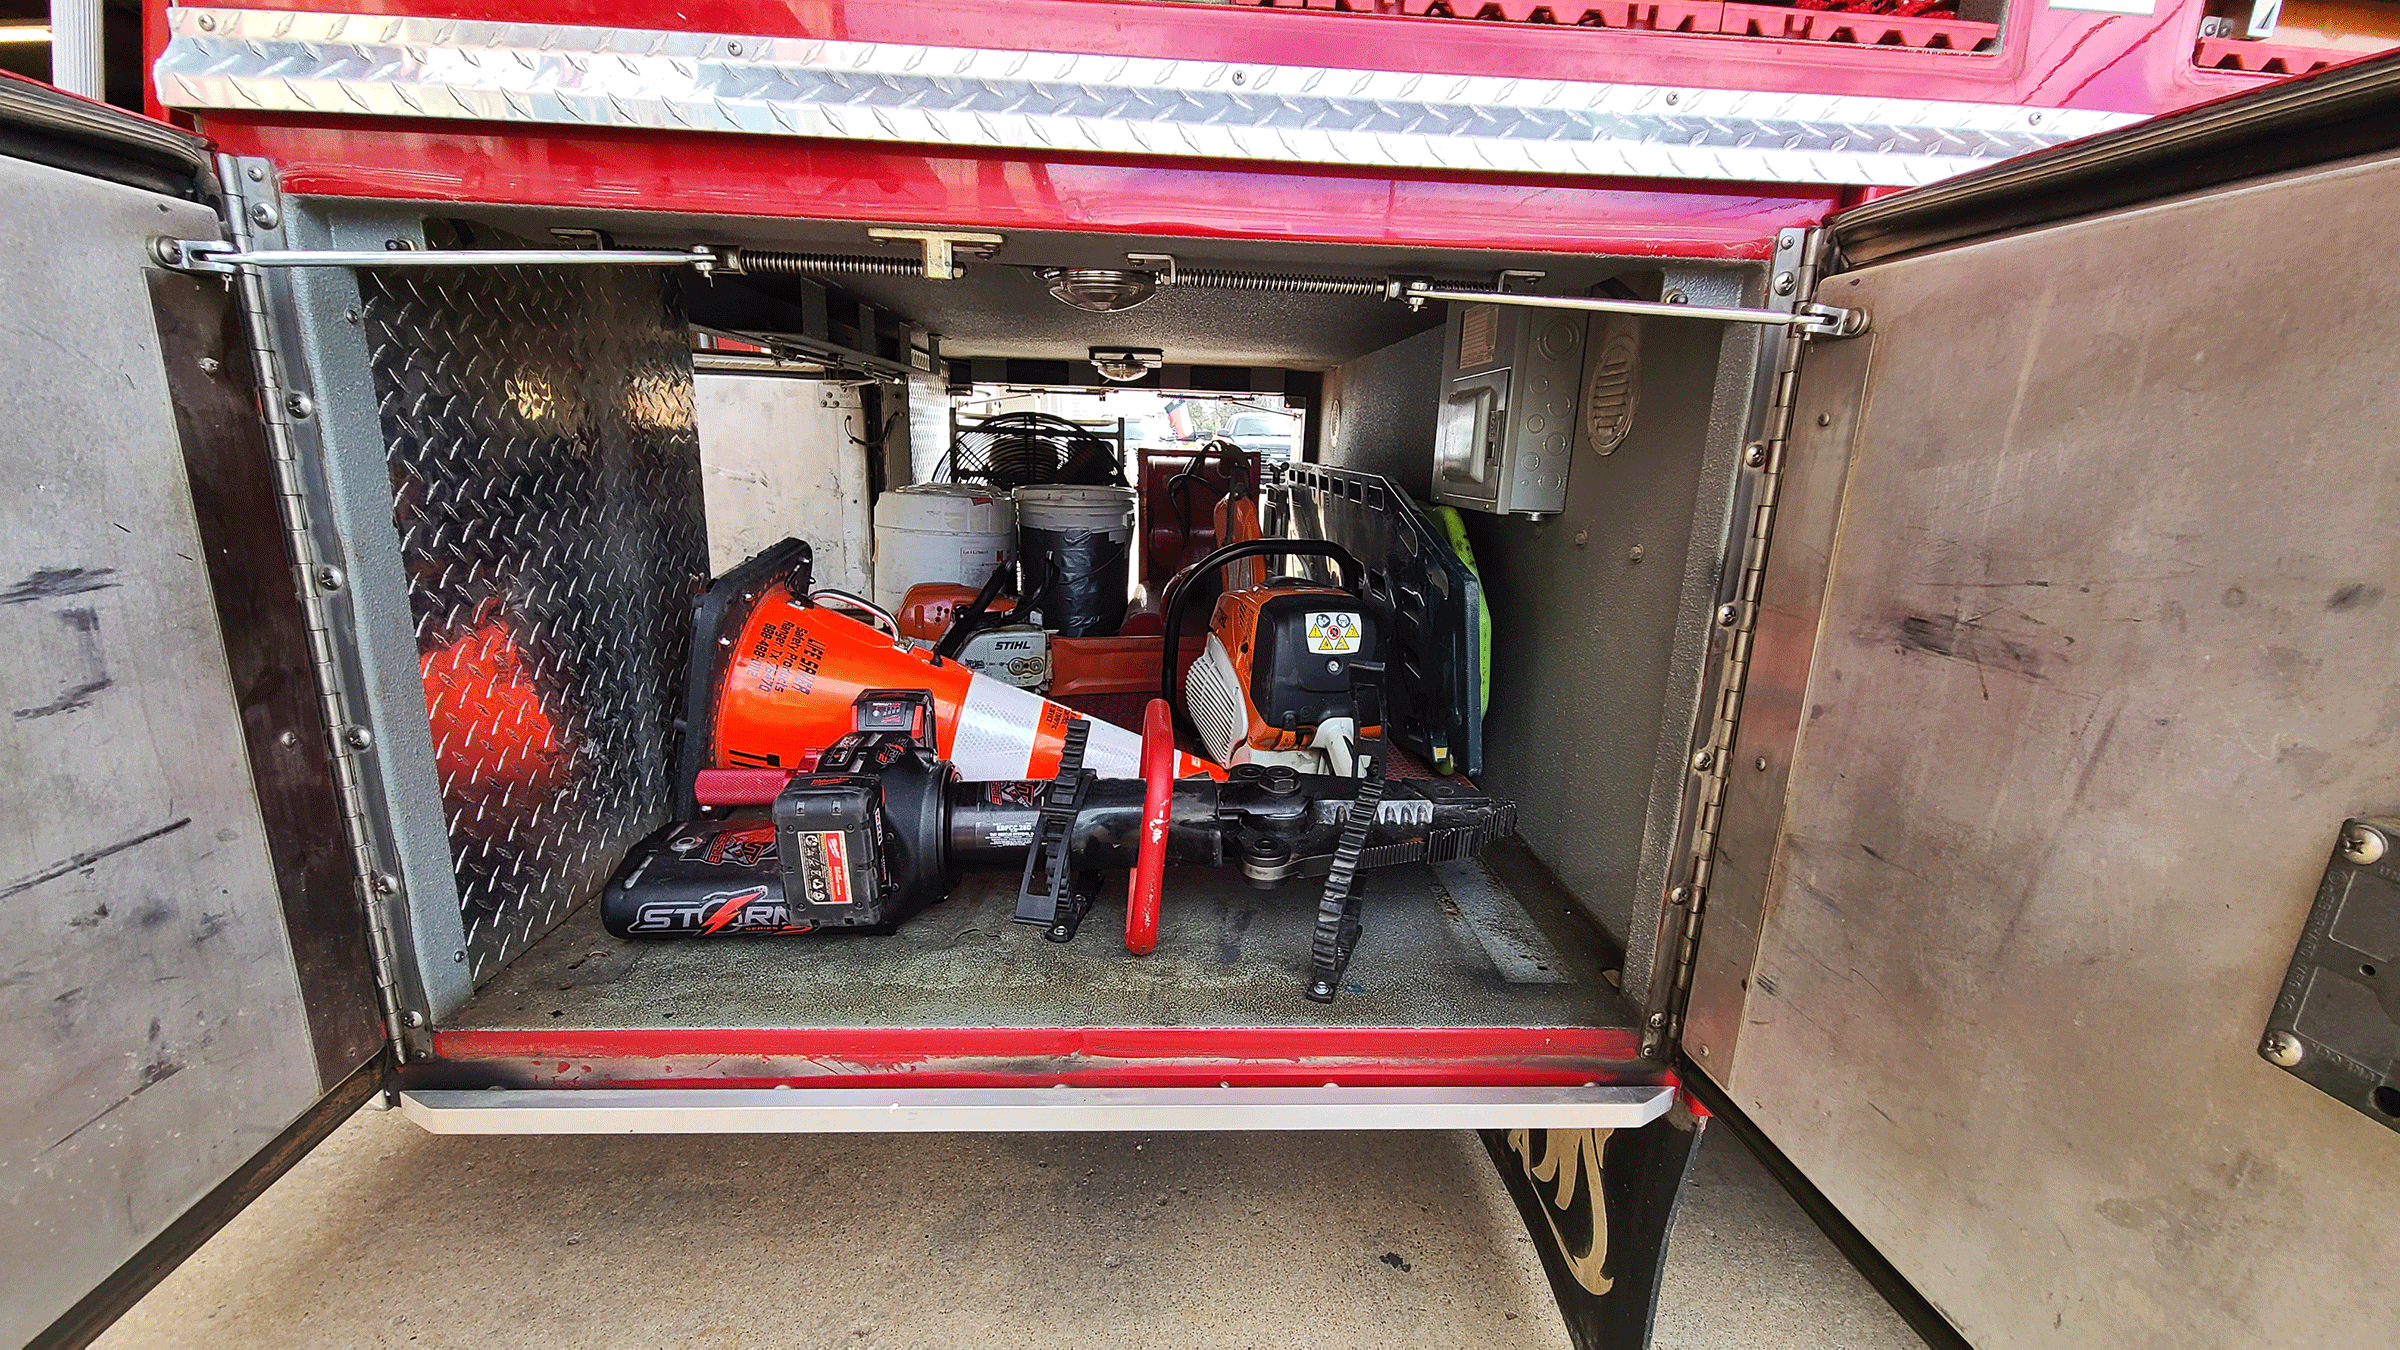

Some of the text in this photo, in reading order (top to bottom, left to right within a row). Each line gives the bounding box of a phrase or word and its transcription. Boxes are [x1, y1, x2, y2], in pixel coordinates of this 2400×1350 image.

[774, 626, 808, 693] Safety Products
[791, 637, 826, 695] LIFE SAVER
[994, 640, 1031, 650] STIHL
